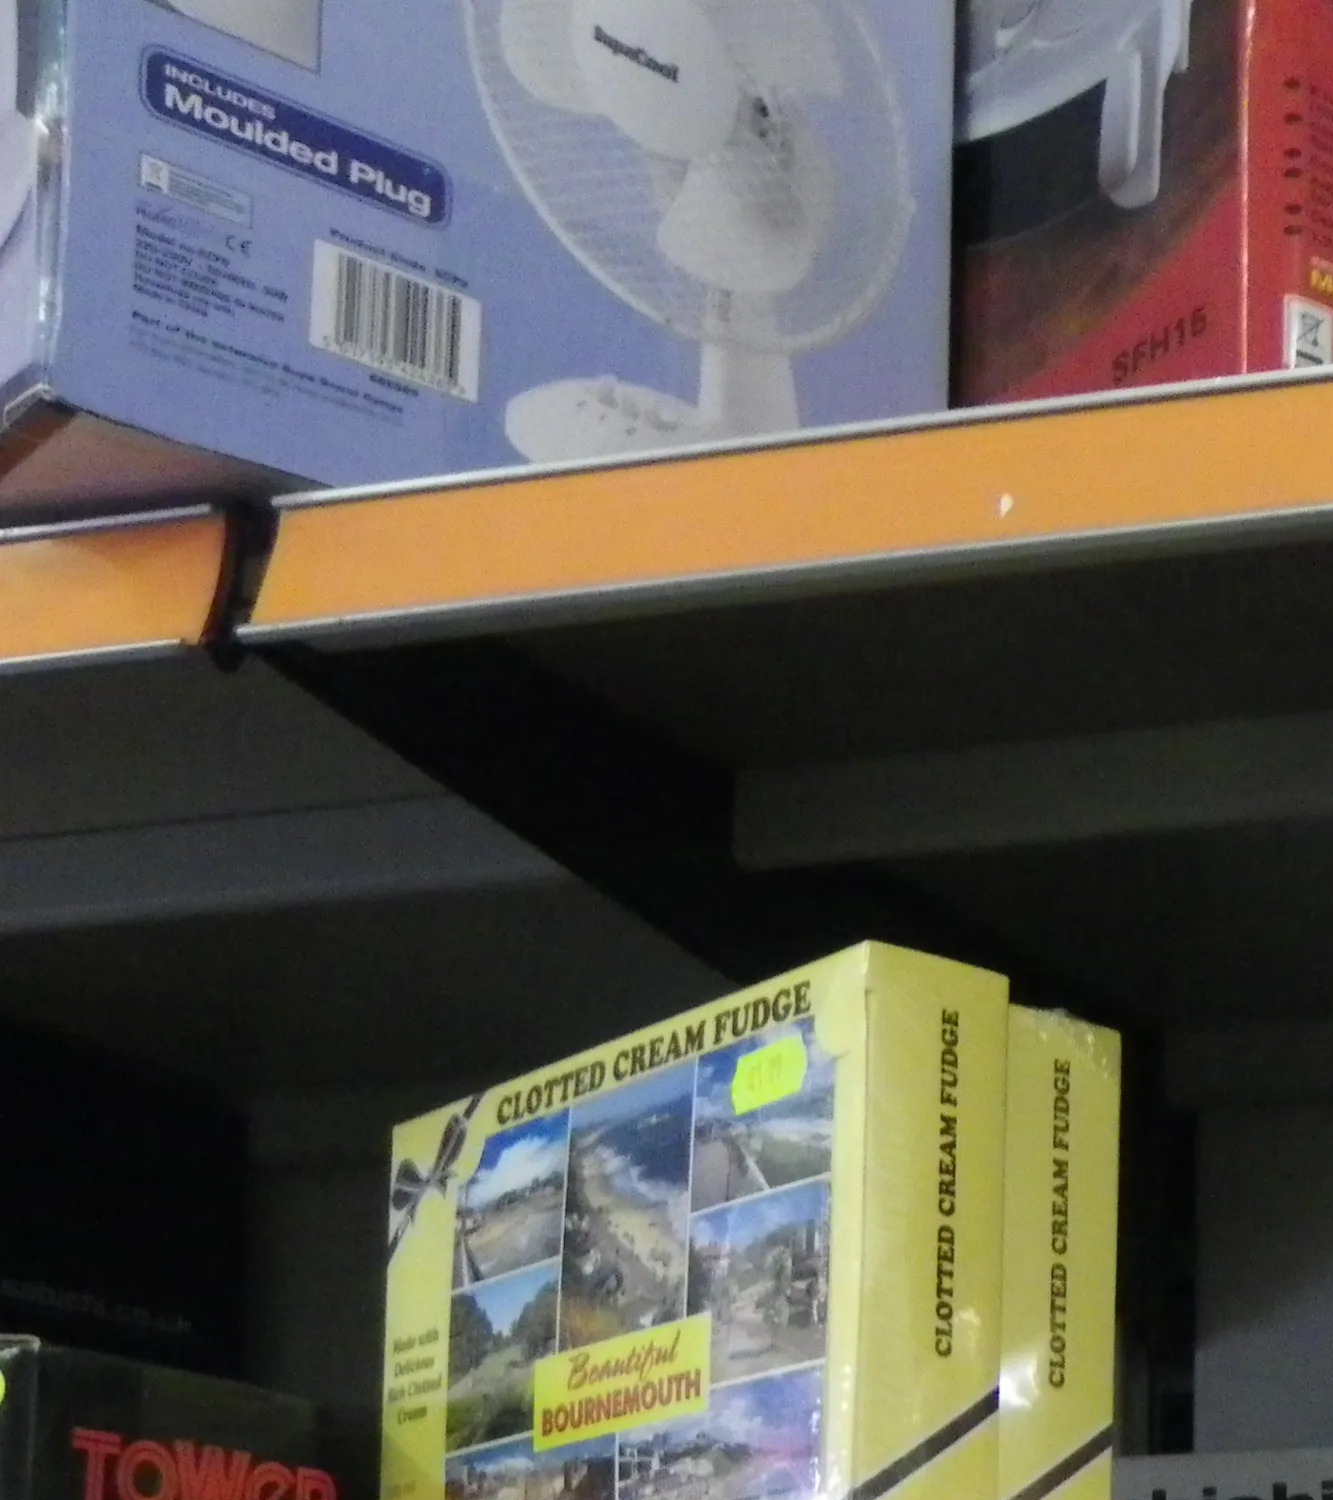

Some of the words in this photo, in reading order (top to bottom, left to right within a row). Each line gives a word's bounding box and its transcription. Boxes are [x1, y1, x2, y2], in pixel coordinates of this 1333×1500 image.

[165, 64, 276, 120] INCLUDES
[165, 83, 338, 175] Moulded
[350, 159, 431, 218] Plug
[497, 1060, 606, 1125] CLOTTED
[613, 1019, 706, 1081] CREAM
[713, 981, 811, 1046] FUDGE
[940, 1008, 960, 1108] FUDGE
[1052, 1057, 1071, 1154] FUDGE
[938, 1113, 958, 1218] CREAM
[1051, 1159, 1069, 1256] CREAM
[934, 1225, 955, 1359] CLOTTED
[1048, 1261, 1068, 1390] CLOTTED
[542, 1368, 701, 1437] BOURNEMOUTH
[567, 1328, 681, 1391] Beautiful
